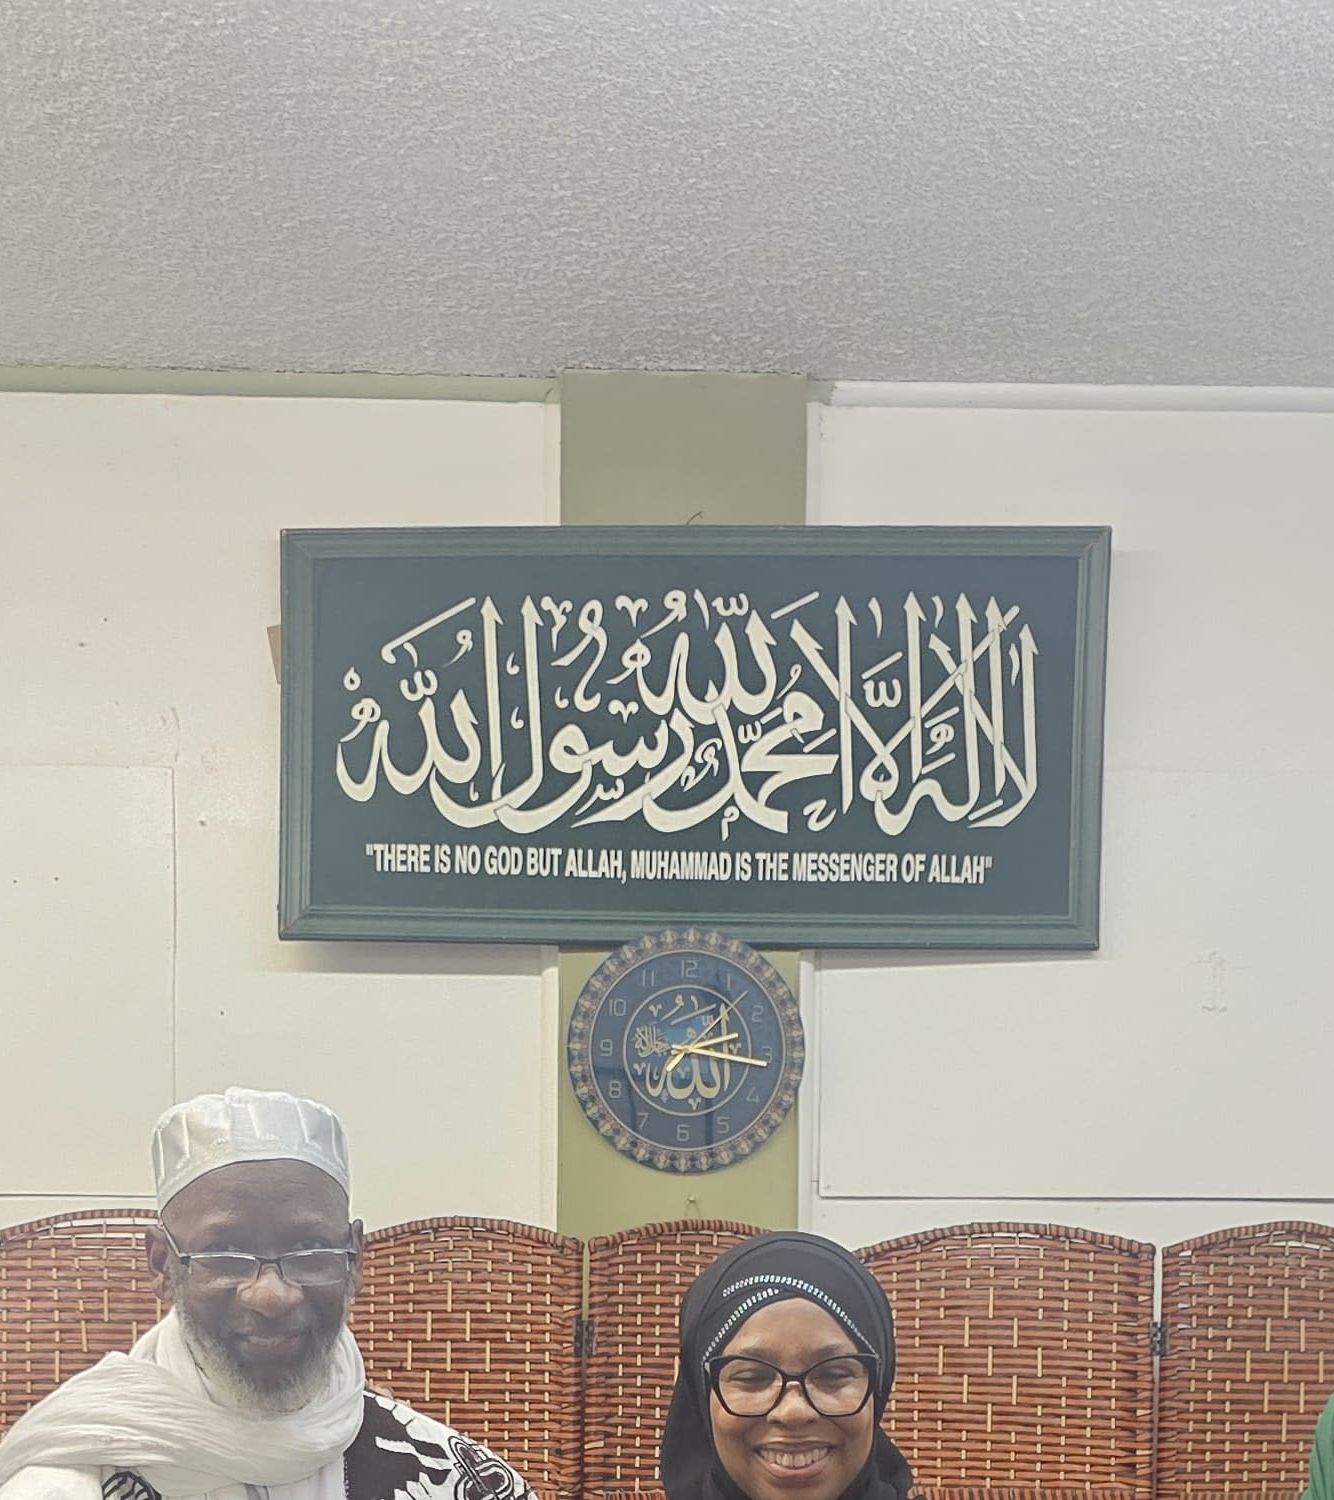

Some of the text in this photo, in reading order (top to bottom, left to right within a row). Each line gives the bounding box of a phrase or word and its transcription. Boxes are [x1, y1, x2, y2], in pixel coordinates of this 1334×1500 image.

[366, 844, 992, 884] "THERE IS NO GOD BUT ALLAH, MUHAMMAD IS THE MESSENGER OF ALLAH"
[680, 960, 698, 977] 12
[642, 970, 655, 987] 11
[609, 999, 627, 1017] 10
[751, 1005, 764, 1022] 2
[600, 1039, 613, 1056] 9
[609, 1081, 622, 1098] 8
[746, 1087, 759, 1104] 4
[638, 1113, 648, 1130] 7
[717, 1116, 730, 1133] 5
[677, 1125, 689, 1142] 6
